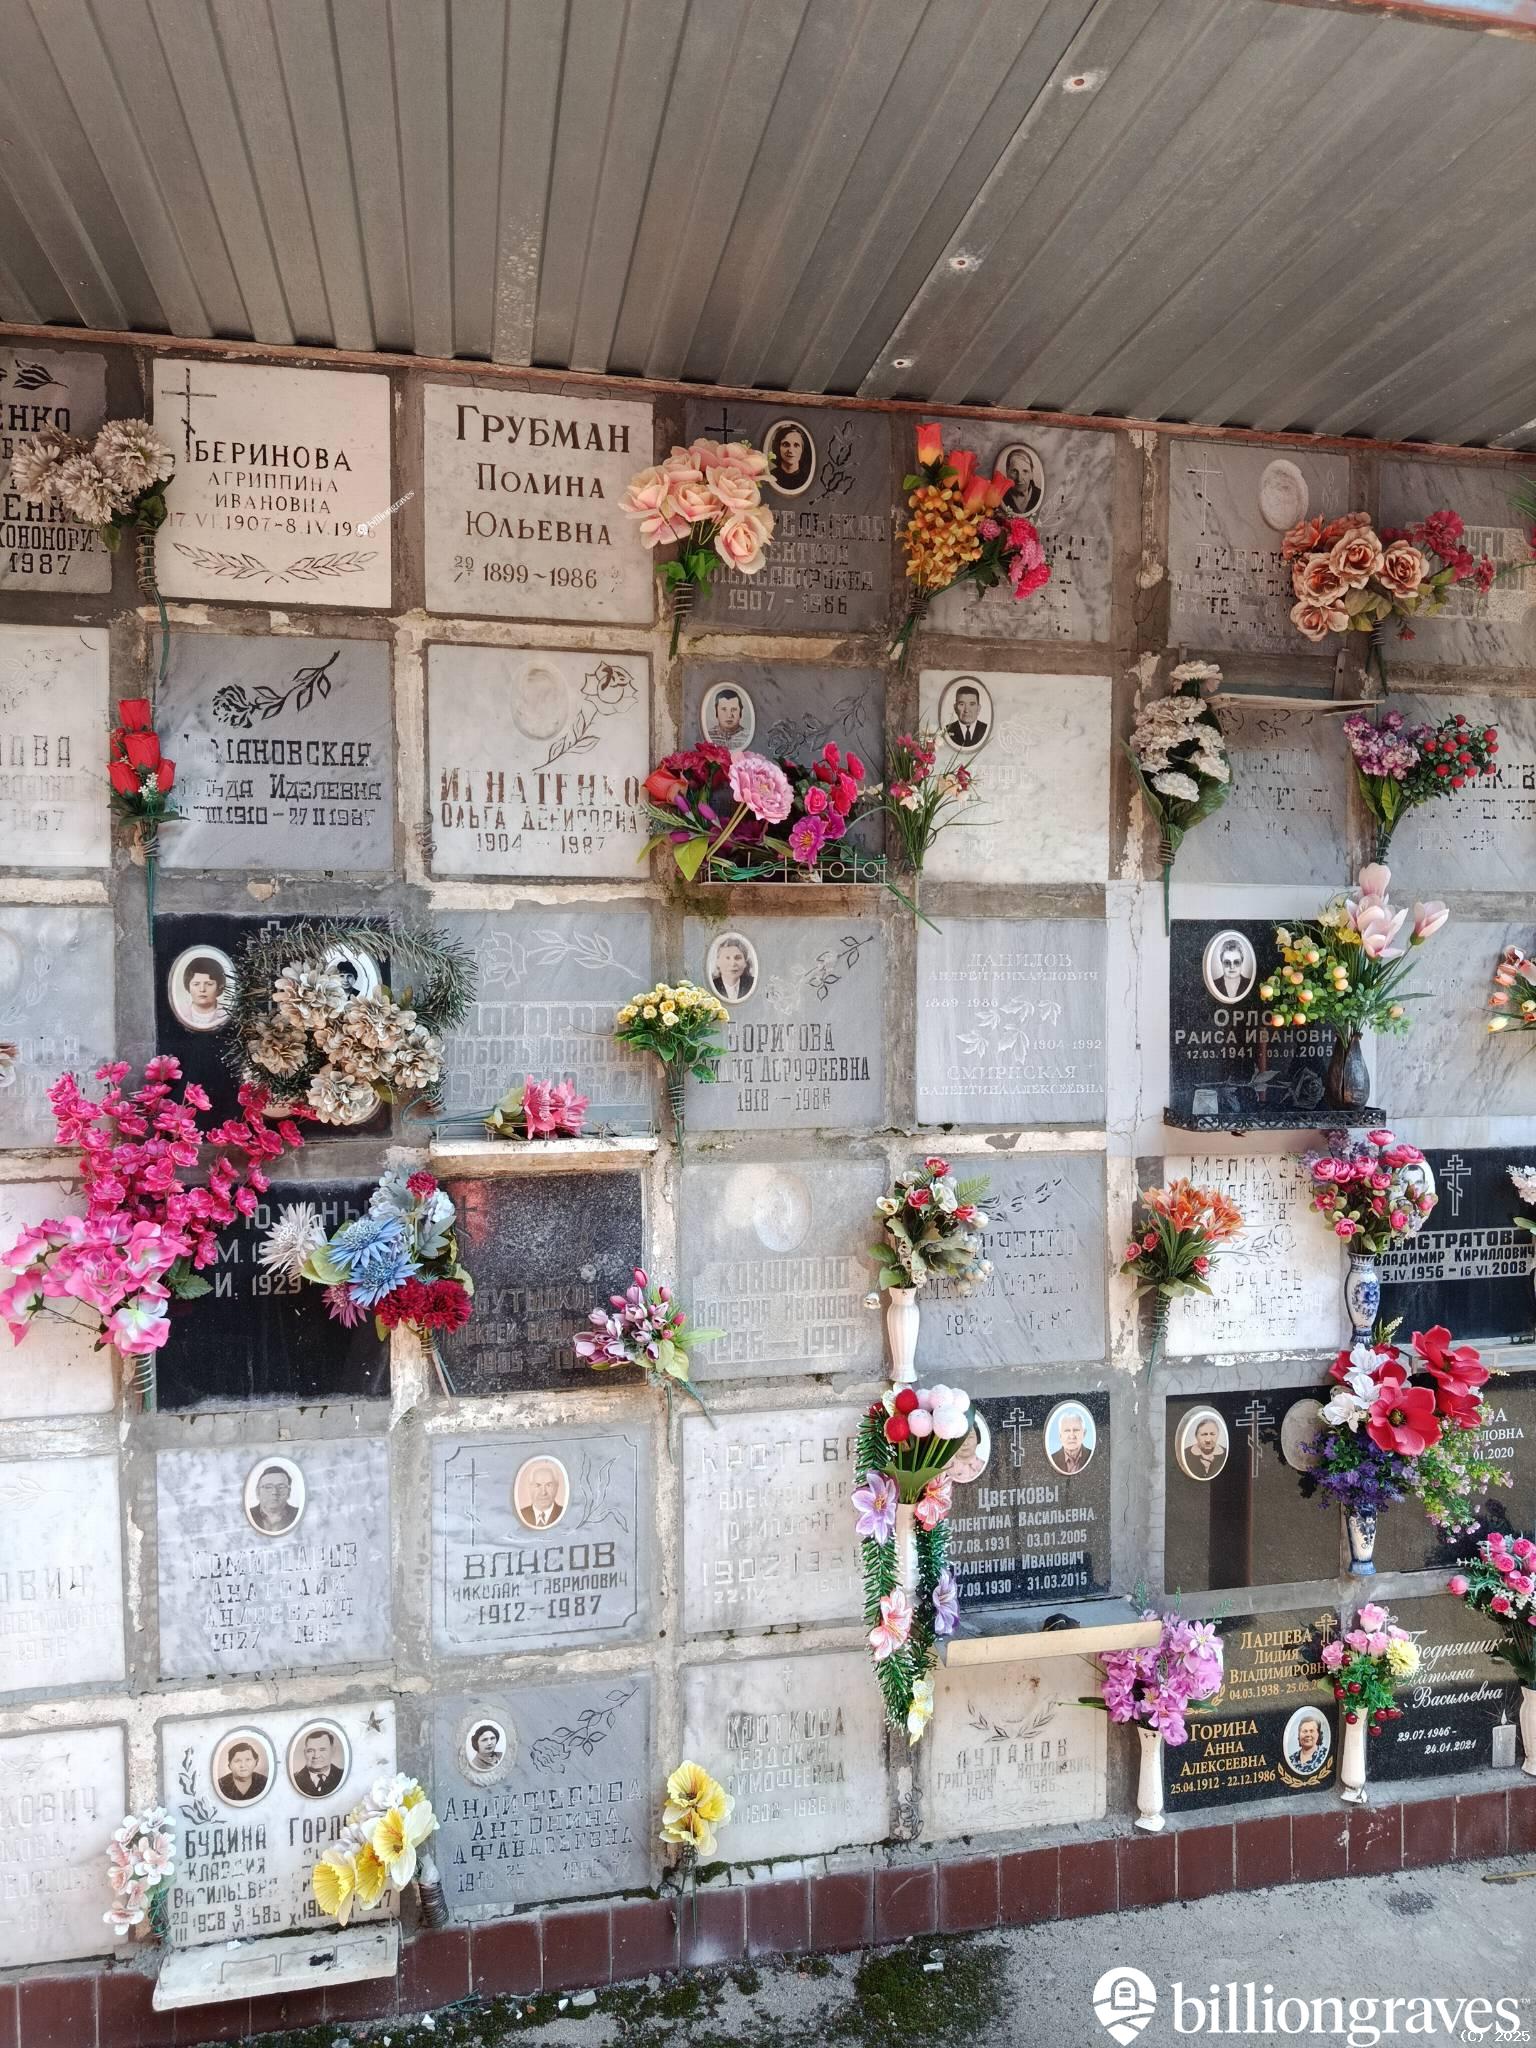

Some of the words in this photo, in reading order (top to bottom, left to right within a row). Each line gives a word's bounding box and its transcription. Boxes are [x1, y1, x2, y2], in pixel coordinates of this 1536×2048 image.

[0, 404, 70, 433] НКО
[456, 405, 630, 453] ГРУБМАН
[195, 440, 352, 473] БЕРИНОВА
[208, 471, 338, 493] АГРИППИНА
[477, 462, 605, 499] ПОЛИНА
[215, 494, 331, 514] ИВАНОВНА
[466, 510, 612, 546] ЮЛЬЕВНА
[9, 553, 71, 576] 1987
[440, 768, 640, 807] ИГНАТЕНКО
[441, 803, 506, 830] ОЛЬГА
[561, 835, 605, 855] 1987
[967, 953, 1072, 968] ДАНИЛОВ
[1214, 1009, 1275, 1027] ОРЛО
[1175, 1030, 1237, 1045] РАИСА
[1246, 1029, 1336, 1043] ИВАНОВН
[1186, 1047, 1253, 1059] 12.03.1941
[1267, 1046, 1333, 1058] 03.01.2005
[1374, 1250, 1445, 1267] ВЛАДИМИР
[1454, 1246, 1535, 1262] КИРИЛЛОВИЧ
[1382, 1265, 1444, 1282] 5.IV.1956
[1482, 1428, 1525, 1441] ЛОВНА
[978, 1485, 1060, 1512] ЦВЕТКОВЫ
[1018, 1507, 1095, 1527] ВАСИЛЬЕВНА
[950, 1536, 1010, 1555] 07.08.1931
[1027, 1529, 1087, 1548] 03.01.2005
[463, 1541, 616, 1580] ВЛАСОВ
[953, 1557, 1016, 1577] ВАЛЕНТИН
[1021, 1550, 1084, 1570] ИВАНОВИЧ
[533, 1571, 628, 1595] ГАВРИЛОВИЧ
[954, 1579, 1012, 1598] 7.09.1930
[1027, 1572, 1087, 1591] 31.03.2015
[1240, 1628, 1313, 1650] ЛАРЦЕВА
[1254, 1649, 1299, 1665] ЛИДИЯ
[1230, 1663, 1328, 1684] ВЛАДИМИРОВН
[1229, 1684, 1280, 1700] 04.03.1938
[1412, 1680, 1503, 1709] Васильевна
[727, 1706, 847, 1750] КРОТКОВА
[1190, 1719, 1259, 1742] ГОРИНА
[1397, 1727, 1451, 1742] 29.07.1946
[1203, 1741, 1245, 1757] АННА
[1424, 1739, 1477, 1755] 24.01.2021
[1180, 1754, 1267, 1777] АЛЕКСЕЕВНА
[1170, 1776, 1220, 1795] 25.04.1912
[1227, 1769, 1276, 1787] 22.12.1986
[443, 1778, 644, 1822] АНЦИФЕРОВА
[471, 1807, 619, 1841] АНТОНИНА
[185, 1823, 267, 1860] БУДИНА
[453, 1826, 633, 1864] АФАНАСЬЕВНА
